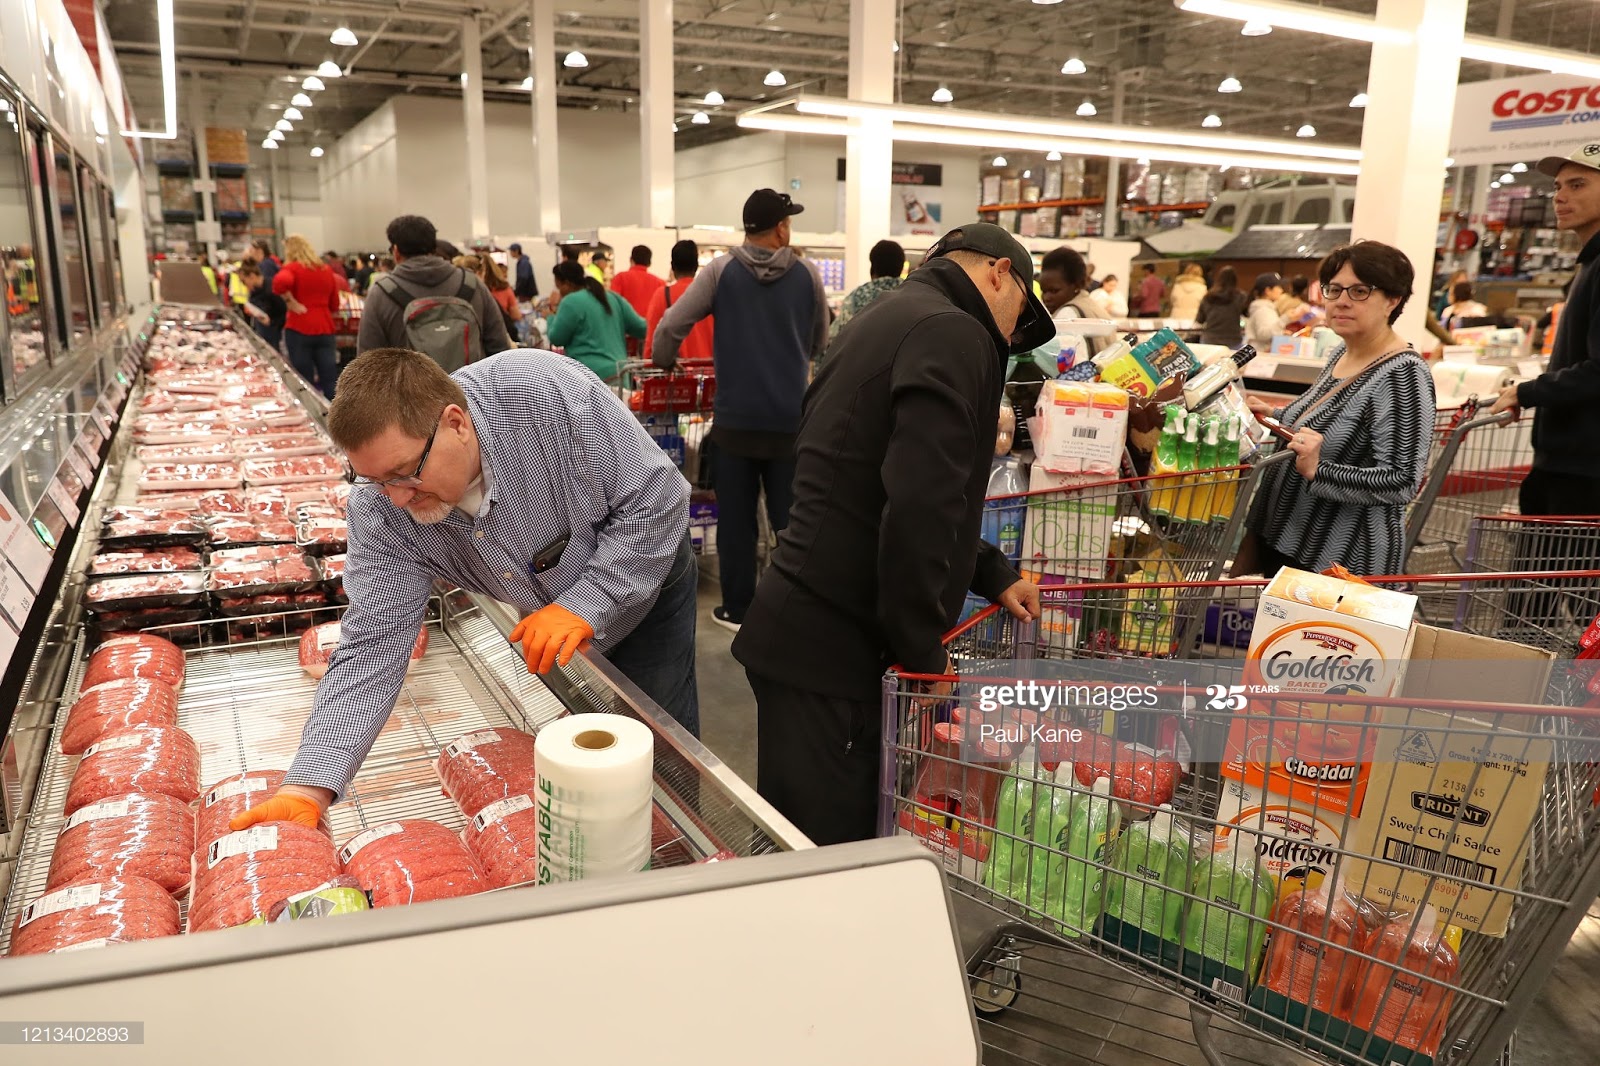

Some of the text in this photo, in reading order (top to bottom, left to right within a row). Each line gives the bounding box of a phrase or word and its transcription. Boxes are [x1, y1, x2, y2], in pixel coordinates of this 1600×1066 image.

[1034, 520, 1103, 554] Oats
[1306, 631, 1353, 650] PEPPERIDGE FARM
[1266, 650, 1375, 682] Goldfish
[1287, 681, 1328, 689] BAKED
[1448, 750, 1471, 762] Gross
[1472, 756, 1501, 770] Wight:
[1443, 779, 1485, 798] 213845
[538, 773, 551, 886] STABLE
[1269, 815, 1300, 826] PEPPEIDGE
[1389, 816, 1425, 835] Sweet
[1428, 827, 1461, 844] Chili
[1254, 838, 1335, 866] oldfish
[1401, 894, 1410, 902] IN
